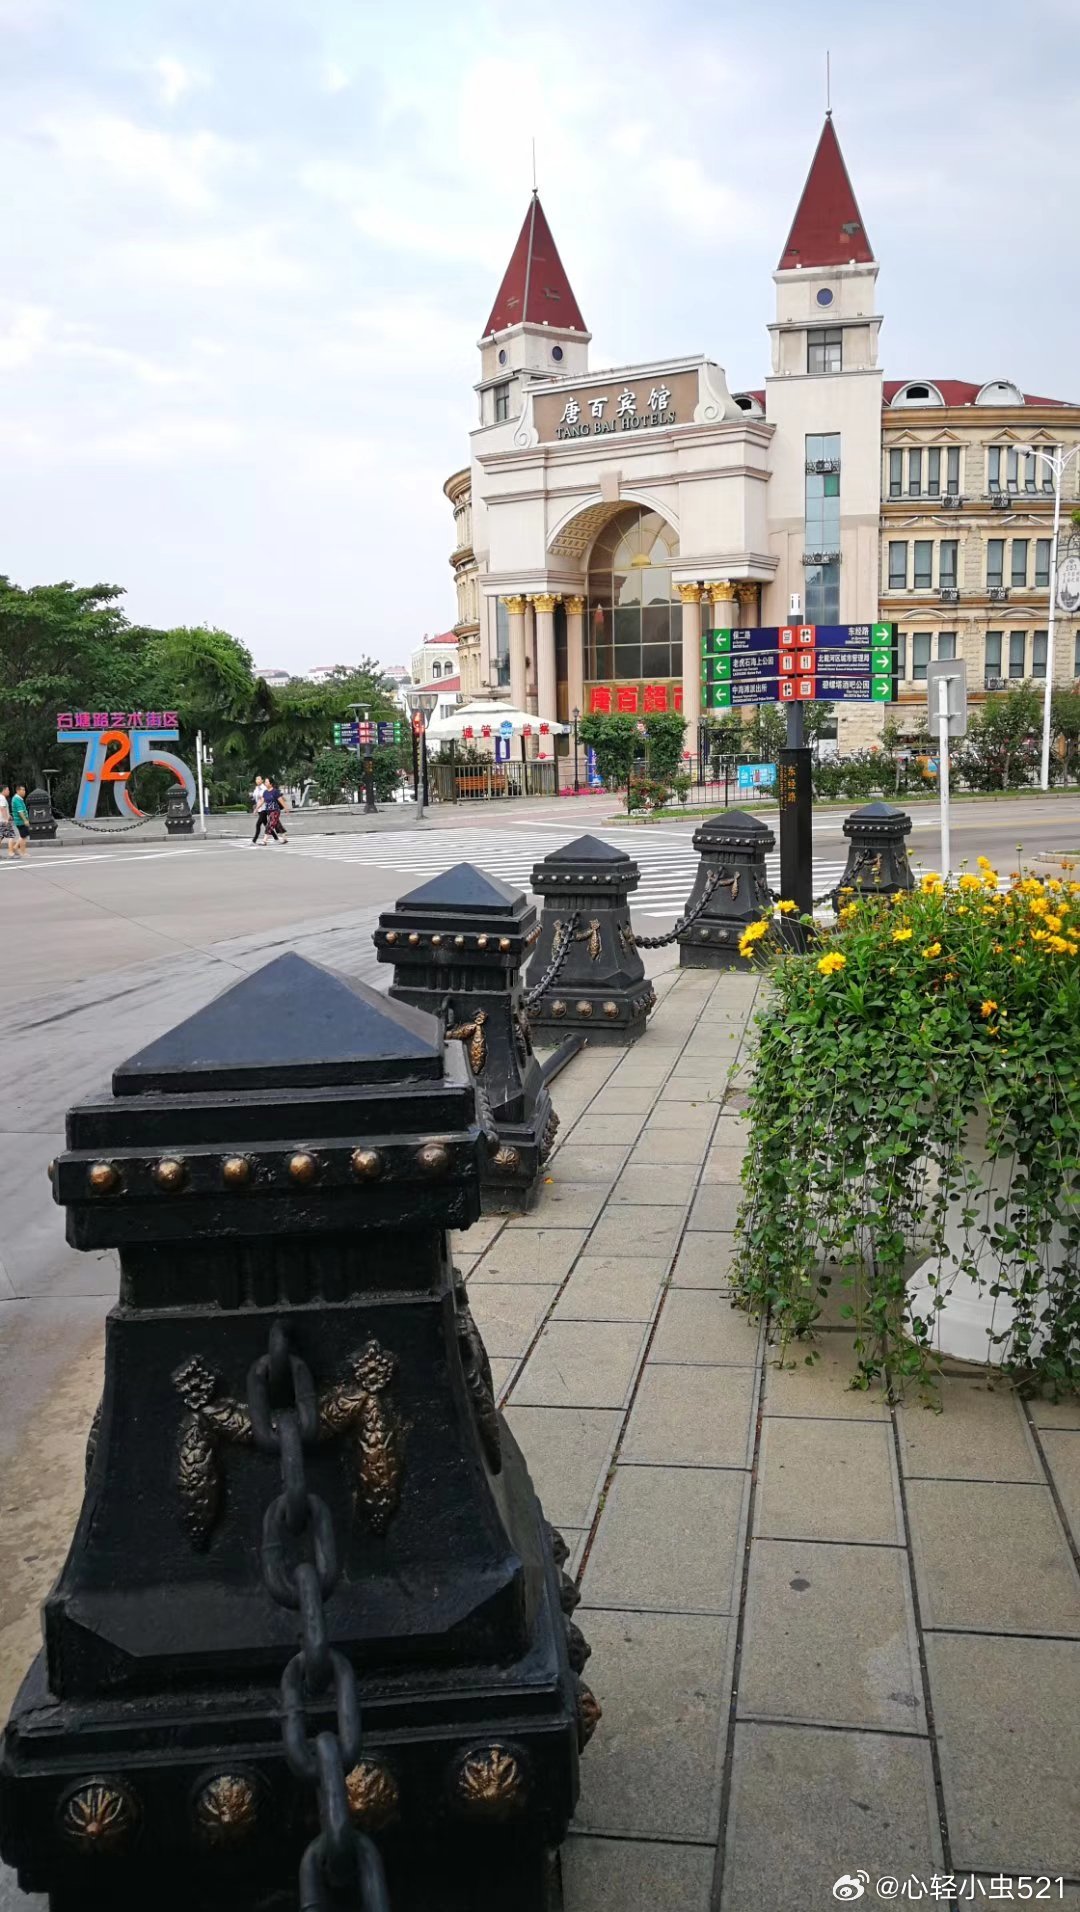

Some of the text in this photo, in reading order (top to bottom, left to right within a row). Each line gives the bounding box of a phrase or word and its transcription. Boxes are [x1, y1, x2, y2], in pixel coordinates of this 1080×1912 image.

[560, 384, 671, 424] 唐百宾馆
[556, 411, 676, 440] TANG BAI HOTELS
[848, 626, 869, 636] 东经路
[733, 656, 774, 668] 老虎石海上公园
[818, 653, 870, 663] 北戴河区城市管理局
[732, 683, 768, 694] 中海滩派出所
[822, 680, 870, 690] 碧螺塔酒吧公园
[57, 711, 179, 728] 石塘路艺术街区
